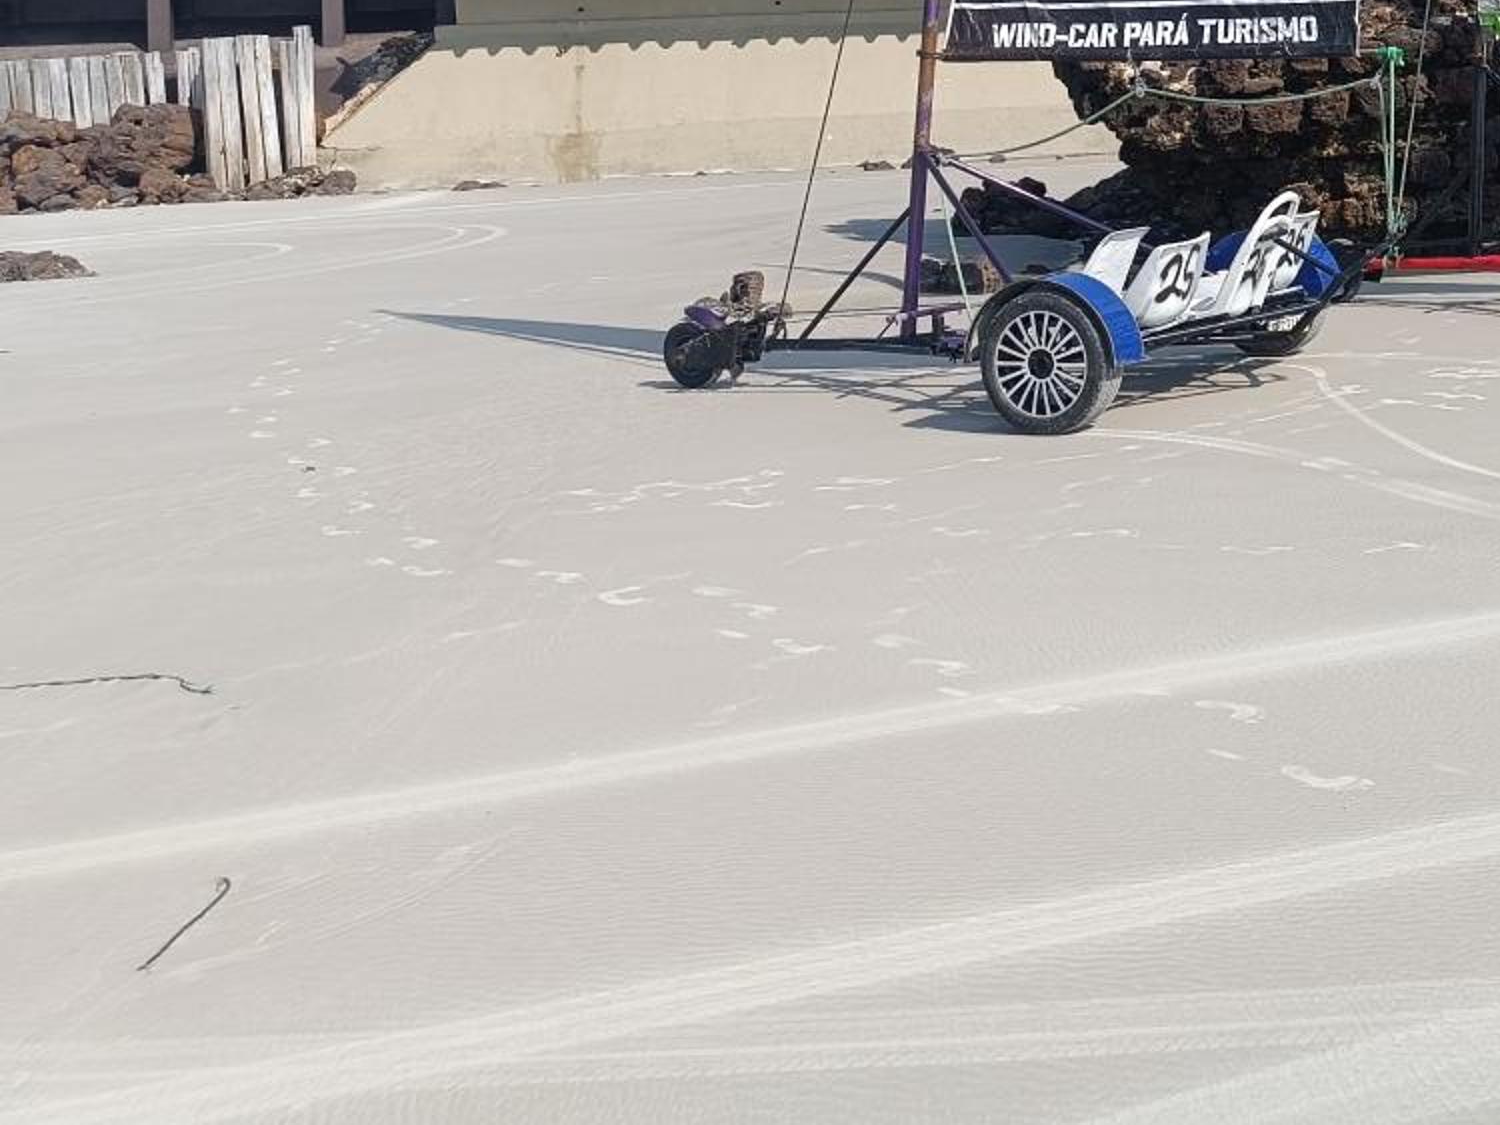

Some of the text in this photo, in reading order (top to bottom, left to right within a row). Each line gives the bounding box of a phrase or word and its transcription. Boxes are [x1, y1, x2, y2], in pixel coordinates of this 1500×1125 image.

[991, 11, 1319, 49] WIND-CAR PARÁ TURISMO
